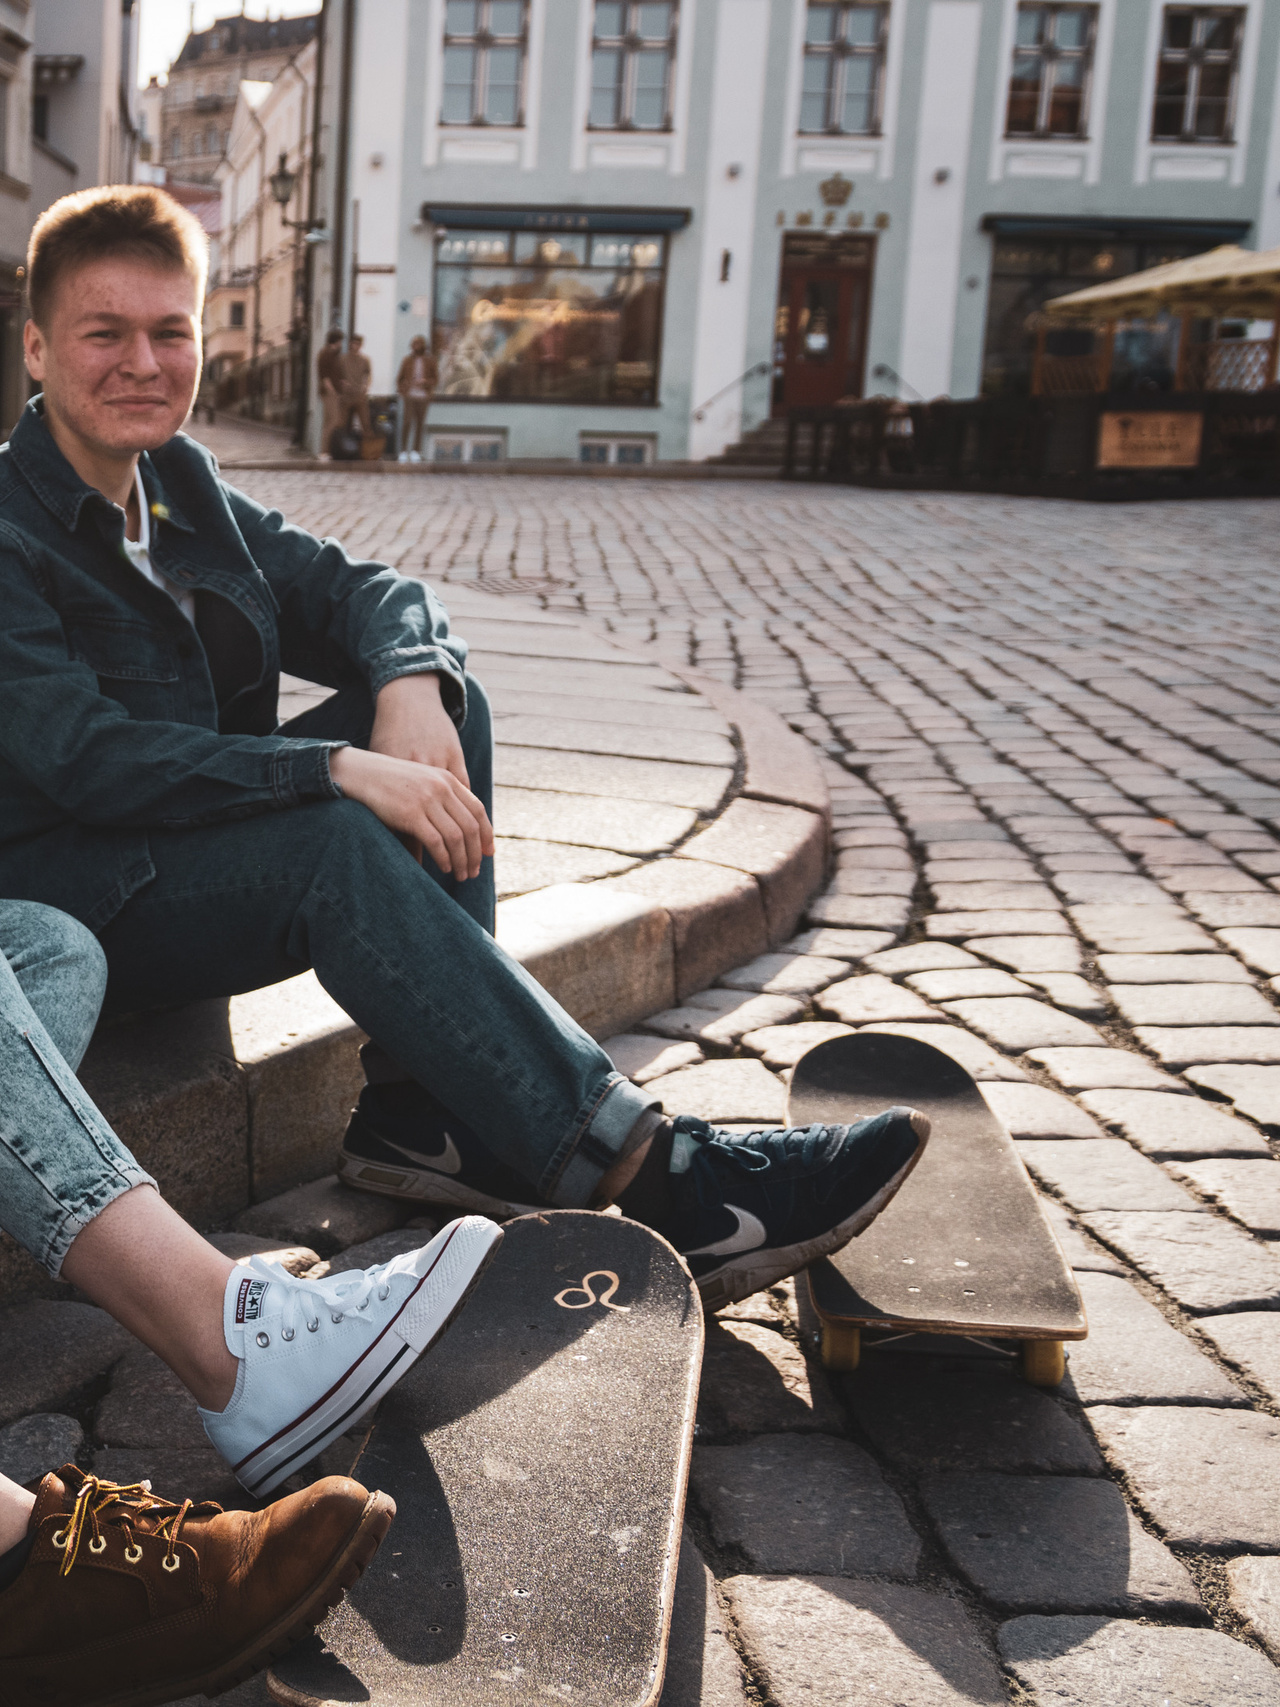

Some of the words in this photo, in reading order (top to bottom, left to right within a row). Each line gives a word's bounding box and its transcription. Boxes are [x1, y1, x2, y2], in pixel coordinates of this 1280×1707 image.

[248, 1281, 266, 1296] STAR
[237, 1281, 249, 1319] CONVERSE
[245, 1306, 259, 1320] ALL
